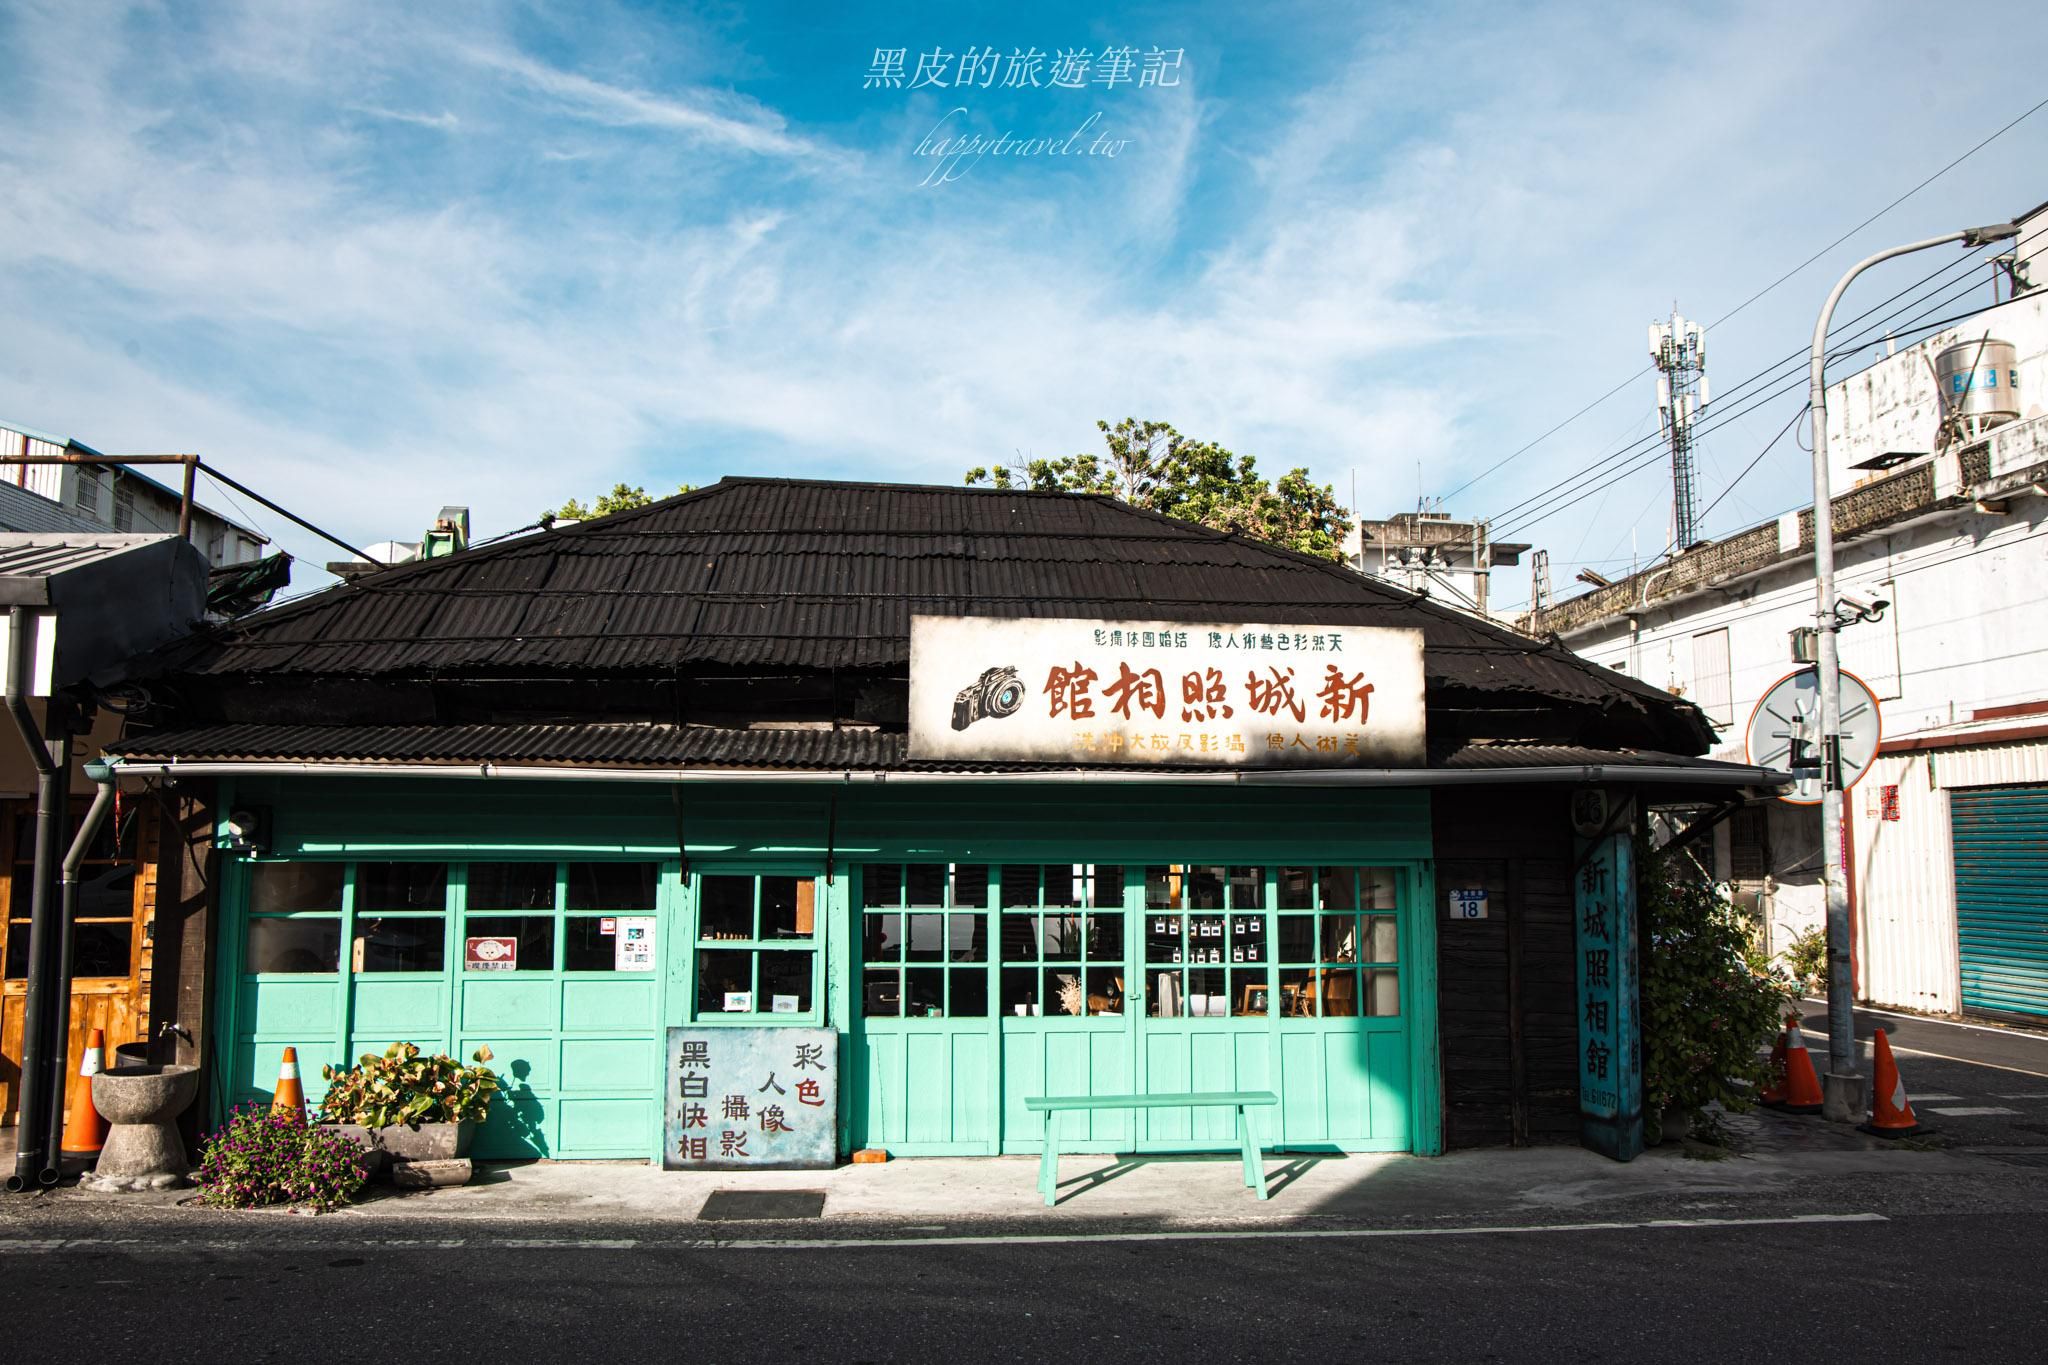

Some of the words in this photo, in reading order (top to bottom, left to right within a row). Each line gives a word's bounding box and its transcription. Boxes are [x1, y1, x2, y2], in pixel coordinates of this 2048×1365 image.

[1042, 660, 1376, 726] 新城照相館
[1460, 901, 1478, 917] 18
[677, 1040, 712, 1161] 黑白快相
[756, 1071, 795, 1133] 人像
[792, 1042, 827, 1108] 彩色
[720, 1094, 751, 1159] 攝影
